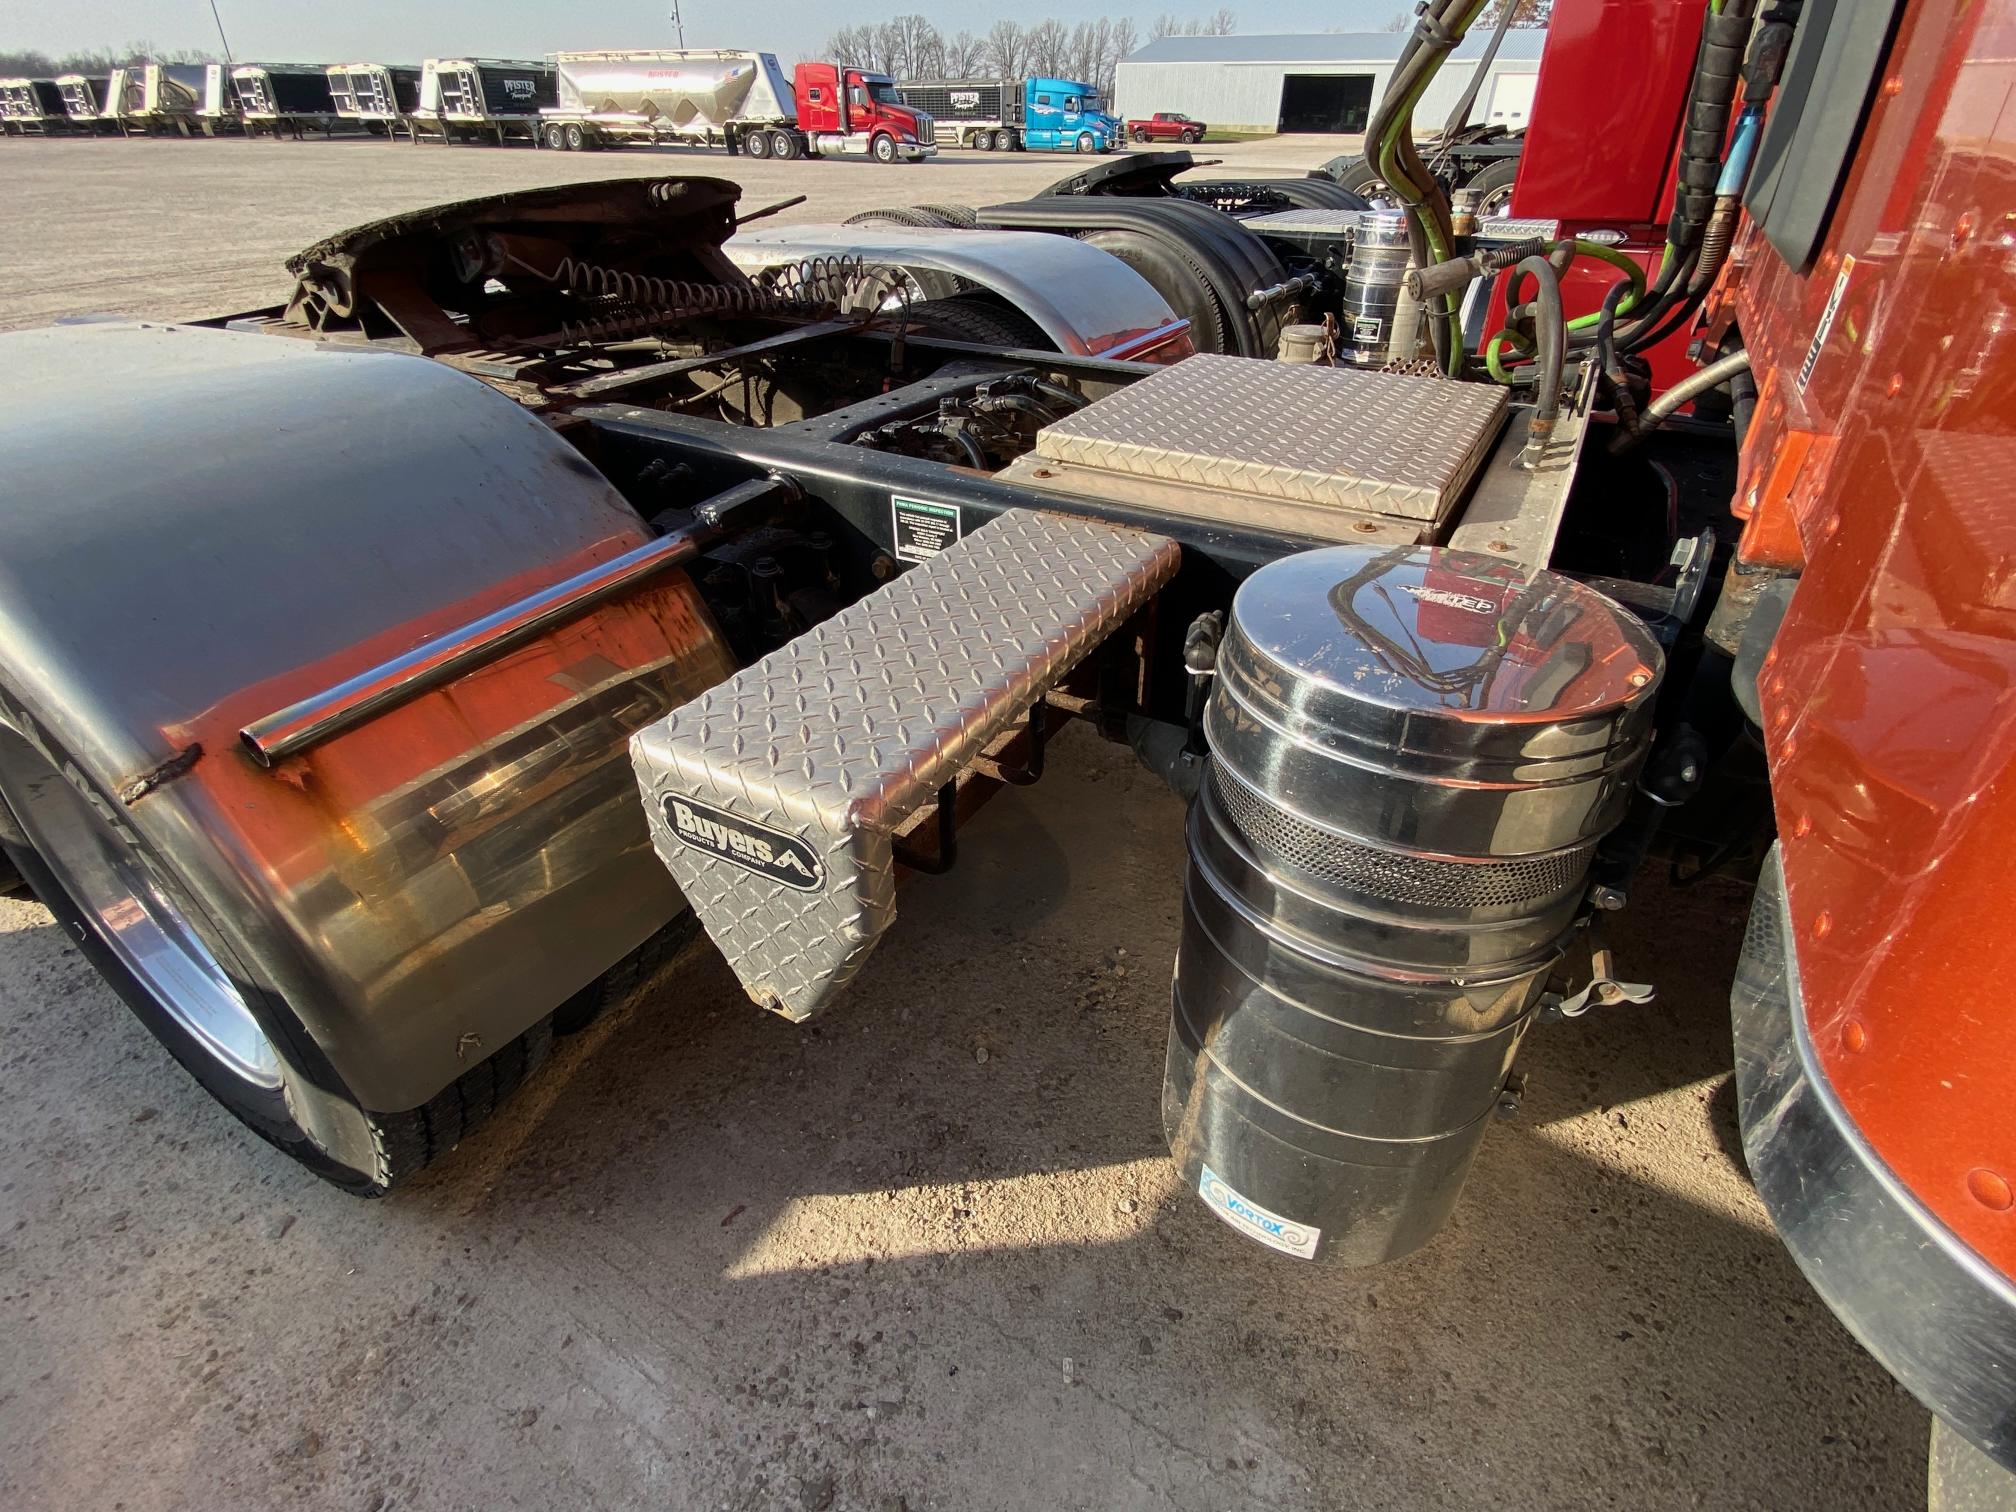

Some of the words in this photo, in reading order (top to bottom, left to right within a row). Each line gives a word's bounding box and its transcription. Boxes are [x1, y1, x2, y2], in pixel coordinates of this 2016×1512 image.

[503, 79, 537, 94] PFISTER
[950, 92, 980, 105] PFISTER
[672, 800, 774, 863] Buyers
[678, 829, 716, 848] PRODUCTS
[731, 849, 766, 868] COMPANY
[1226, 1193, 1284, 1236] VORTOX
